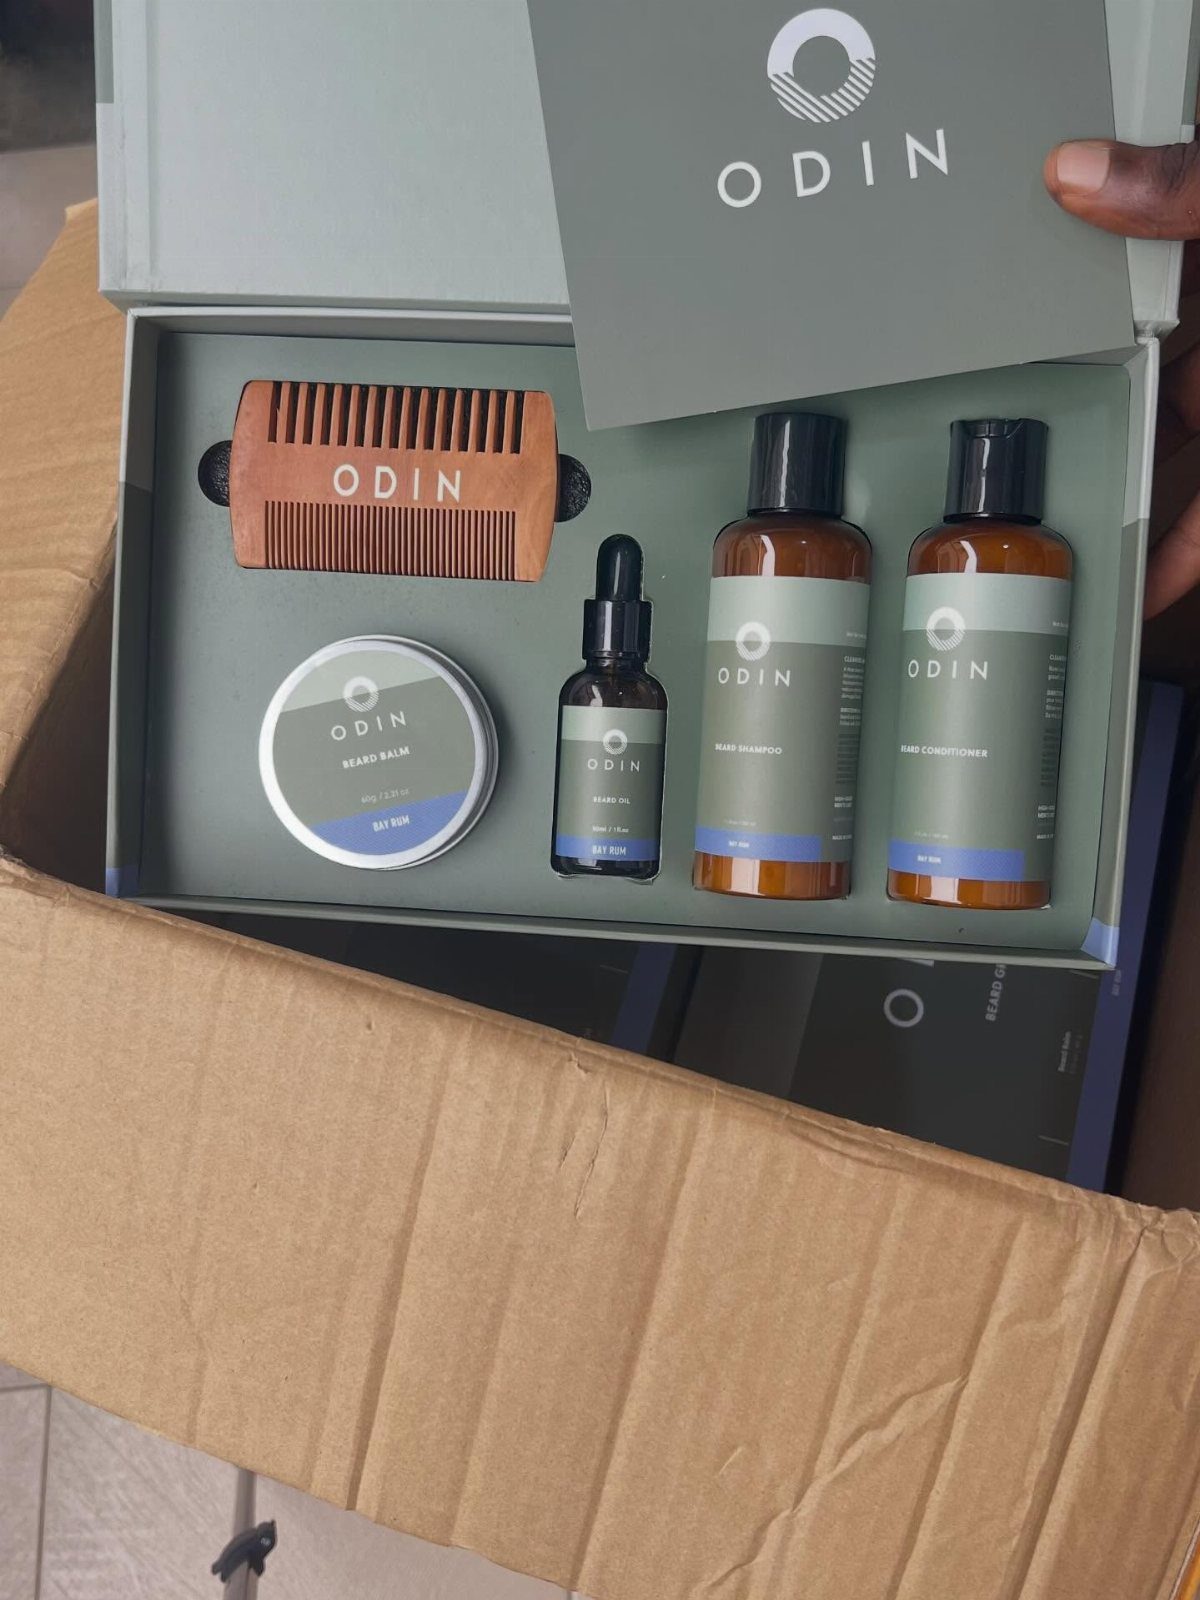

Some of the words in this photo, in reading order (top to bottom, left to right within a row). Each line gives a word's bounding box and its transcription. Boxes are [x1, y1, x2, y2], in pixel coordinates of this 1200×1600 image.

[717, 128, 949, 209] ODIN
[333, 464, 461, 503] ODIN
[717, 667, 791, 688] ODIN
[907, 659, 989, 681] ODIN
[330, 711, 408, 741] ODIN
[342, 753, 378, 769] BEARD
[379, 746, 411, 761] BALM
[714, 743, 738, 752] BEARD
[738, 744, 783, 755] SHAMPOO
[900, 745, 921, 754] BEARD
[921, 745, 989, 758] CONDITIONER
[587, 758, 640, 772] ODIN
[593, 796, 617, 804] BEARD
[618, 797, 631, 805] OIL
[372, 820, 391, 833] BAY
[390, 814, 410, 829] RUM
[592, 844, 608, 855] BAY
[608, 845, 627, 857] RUM
[985, 980, 1004, 1022] BEARD
